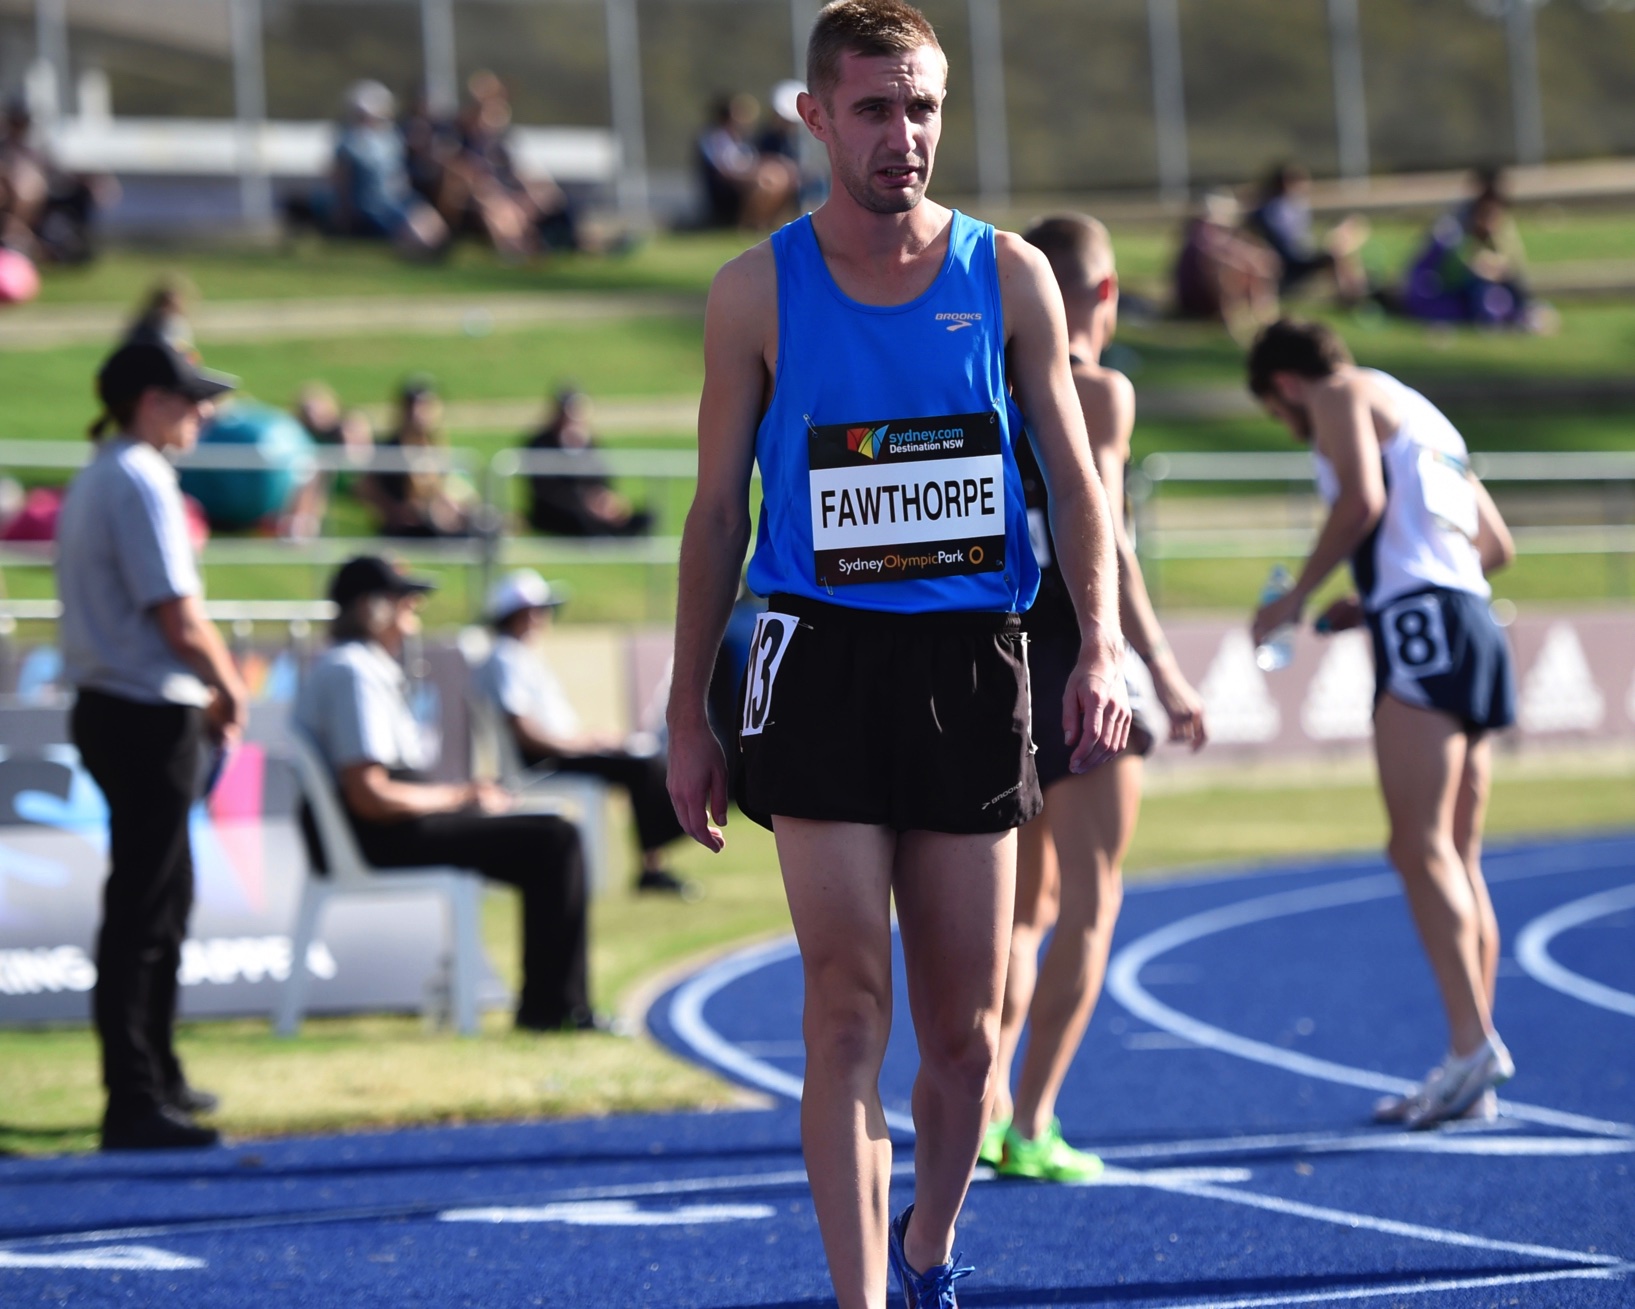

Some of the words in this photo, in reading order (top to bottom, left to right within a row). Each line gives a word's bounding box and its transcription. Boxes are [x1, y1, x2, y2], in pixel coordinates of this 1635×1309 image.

[889, 428, 964, 446] sydney.com
[889, 442, 941, 454] Destination
[943, 439, 964, 450] NSW
[820, 477, 995, 528] FAWTHORPE
[1395, 610, 1436, 666] 8
